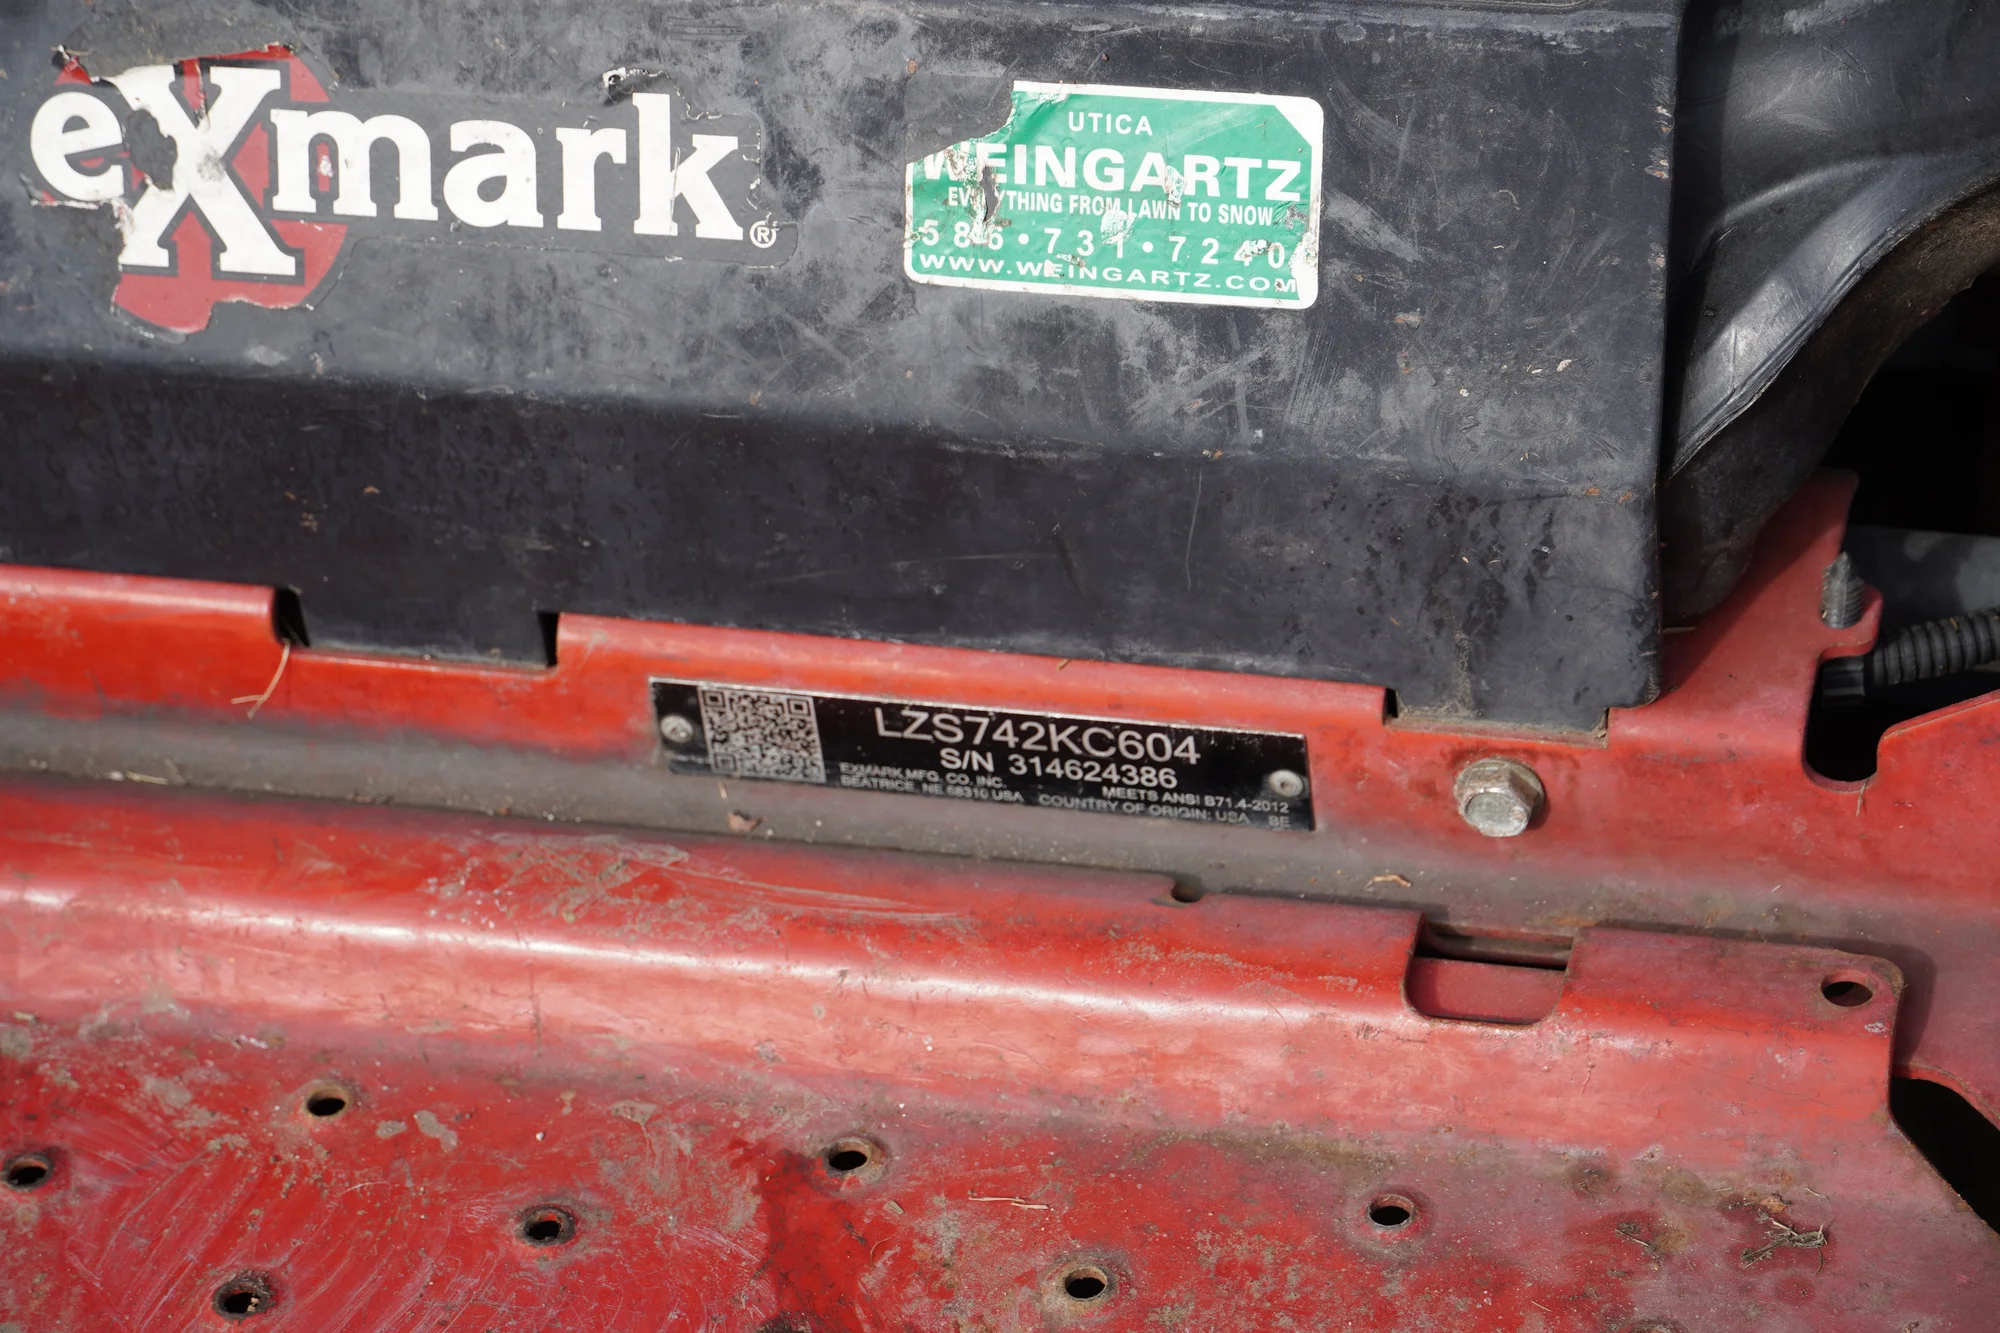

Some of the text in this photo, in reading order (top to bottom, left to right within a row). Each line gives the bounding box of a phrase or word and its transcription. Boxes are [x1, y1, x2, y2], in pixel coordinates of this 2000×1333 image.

[1068, 110, 1153, 137] UTICA
[922, 142, 1302, 202] WEINGARTZ
[1068, 193, 1121, 218] FROM
[1127, 197, 1181, 221] LAWN
[1188, 202, 1213, 222] TO
[1218, 204, 1273, 227] SNOW
[919, 253, 1296, 292] WWW.WEINGARTZ.COM
[875, 707, 1201, 765] LZS742KC604
[940, 748, 1178, 789] S/N 314624386
[945, 772, 974, 786] CO.
[975, 775, 1008, 789] INC.
[921, 783, 944, 796] NE
[991, 788, 1024, 803] USA
[1038, 793, 1119, 812] COUNTRY
[1122, 802, 1146, 815] OF
[1214, 810, 1251, 825] USA
[1101, 786, 1291, 815] MEETS ANSI B71.4-2012
